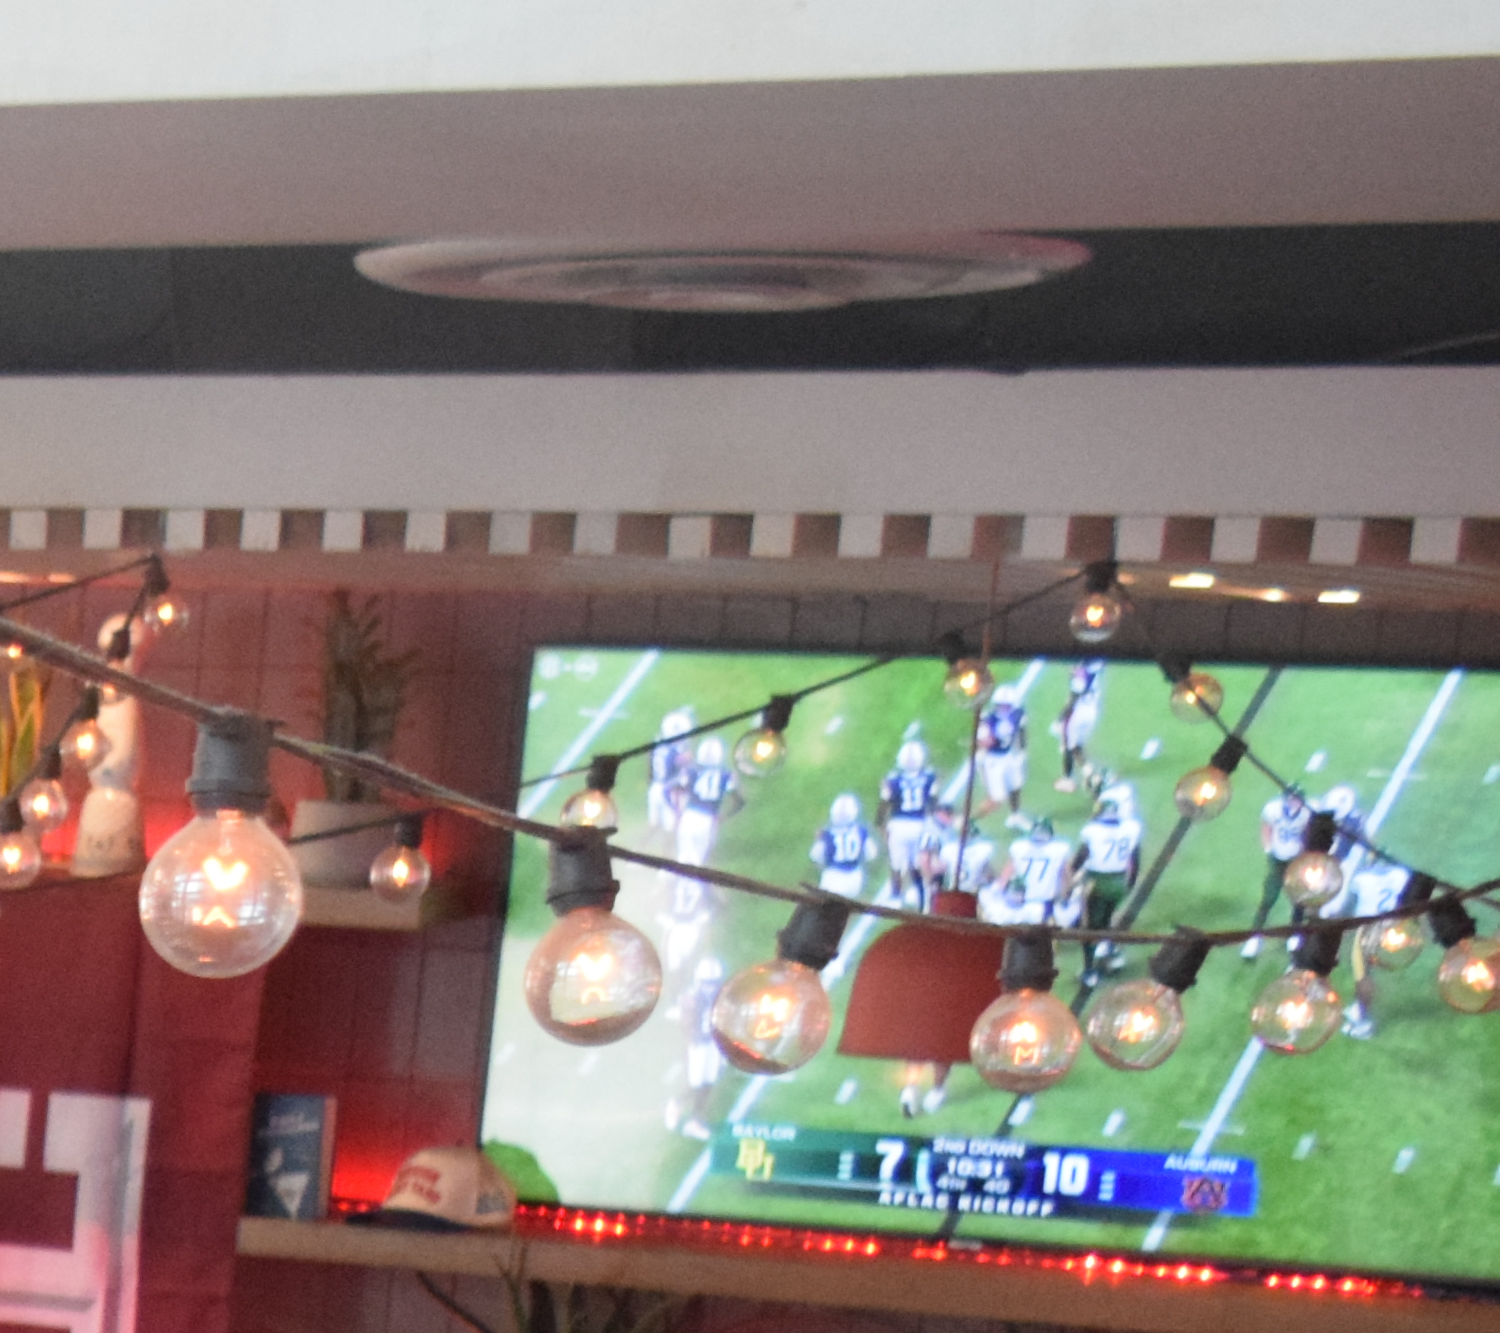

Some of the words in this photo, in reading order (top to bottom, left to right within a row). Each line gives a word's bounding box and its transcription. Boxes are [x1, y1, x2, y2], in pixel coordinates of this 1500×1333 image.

[833, 831, 862, 862] 10
[1104, 838, 1131, 860] 78
[1021, 857, 1049, 881] 77
[875, 1140, 906, 1181] 7
[969, 1139, 1026, 1159] DOWN
[1042, 1151, 1090, 1197] 10
[1164, 1153, 1238, 1174] AUBURN
